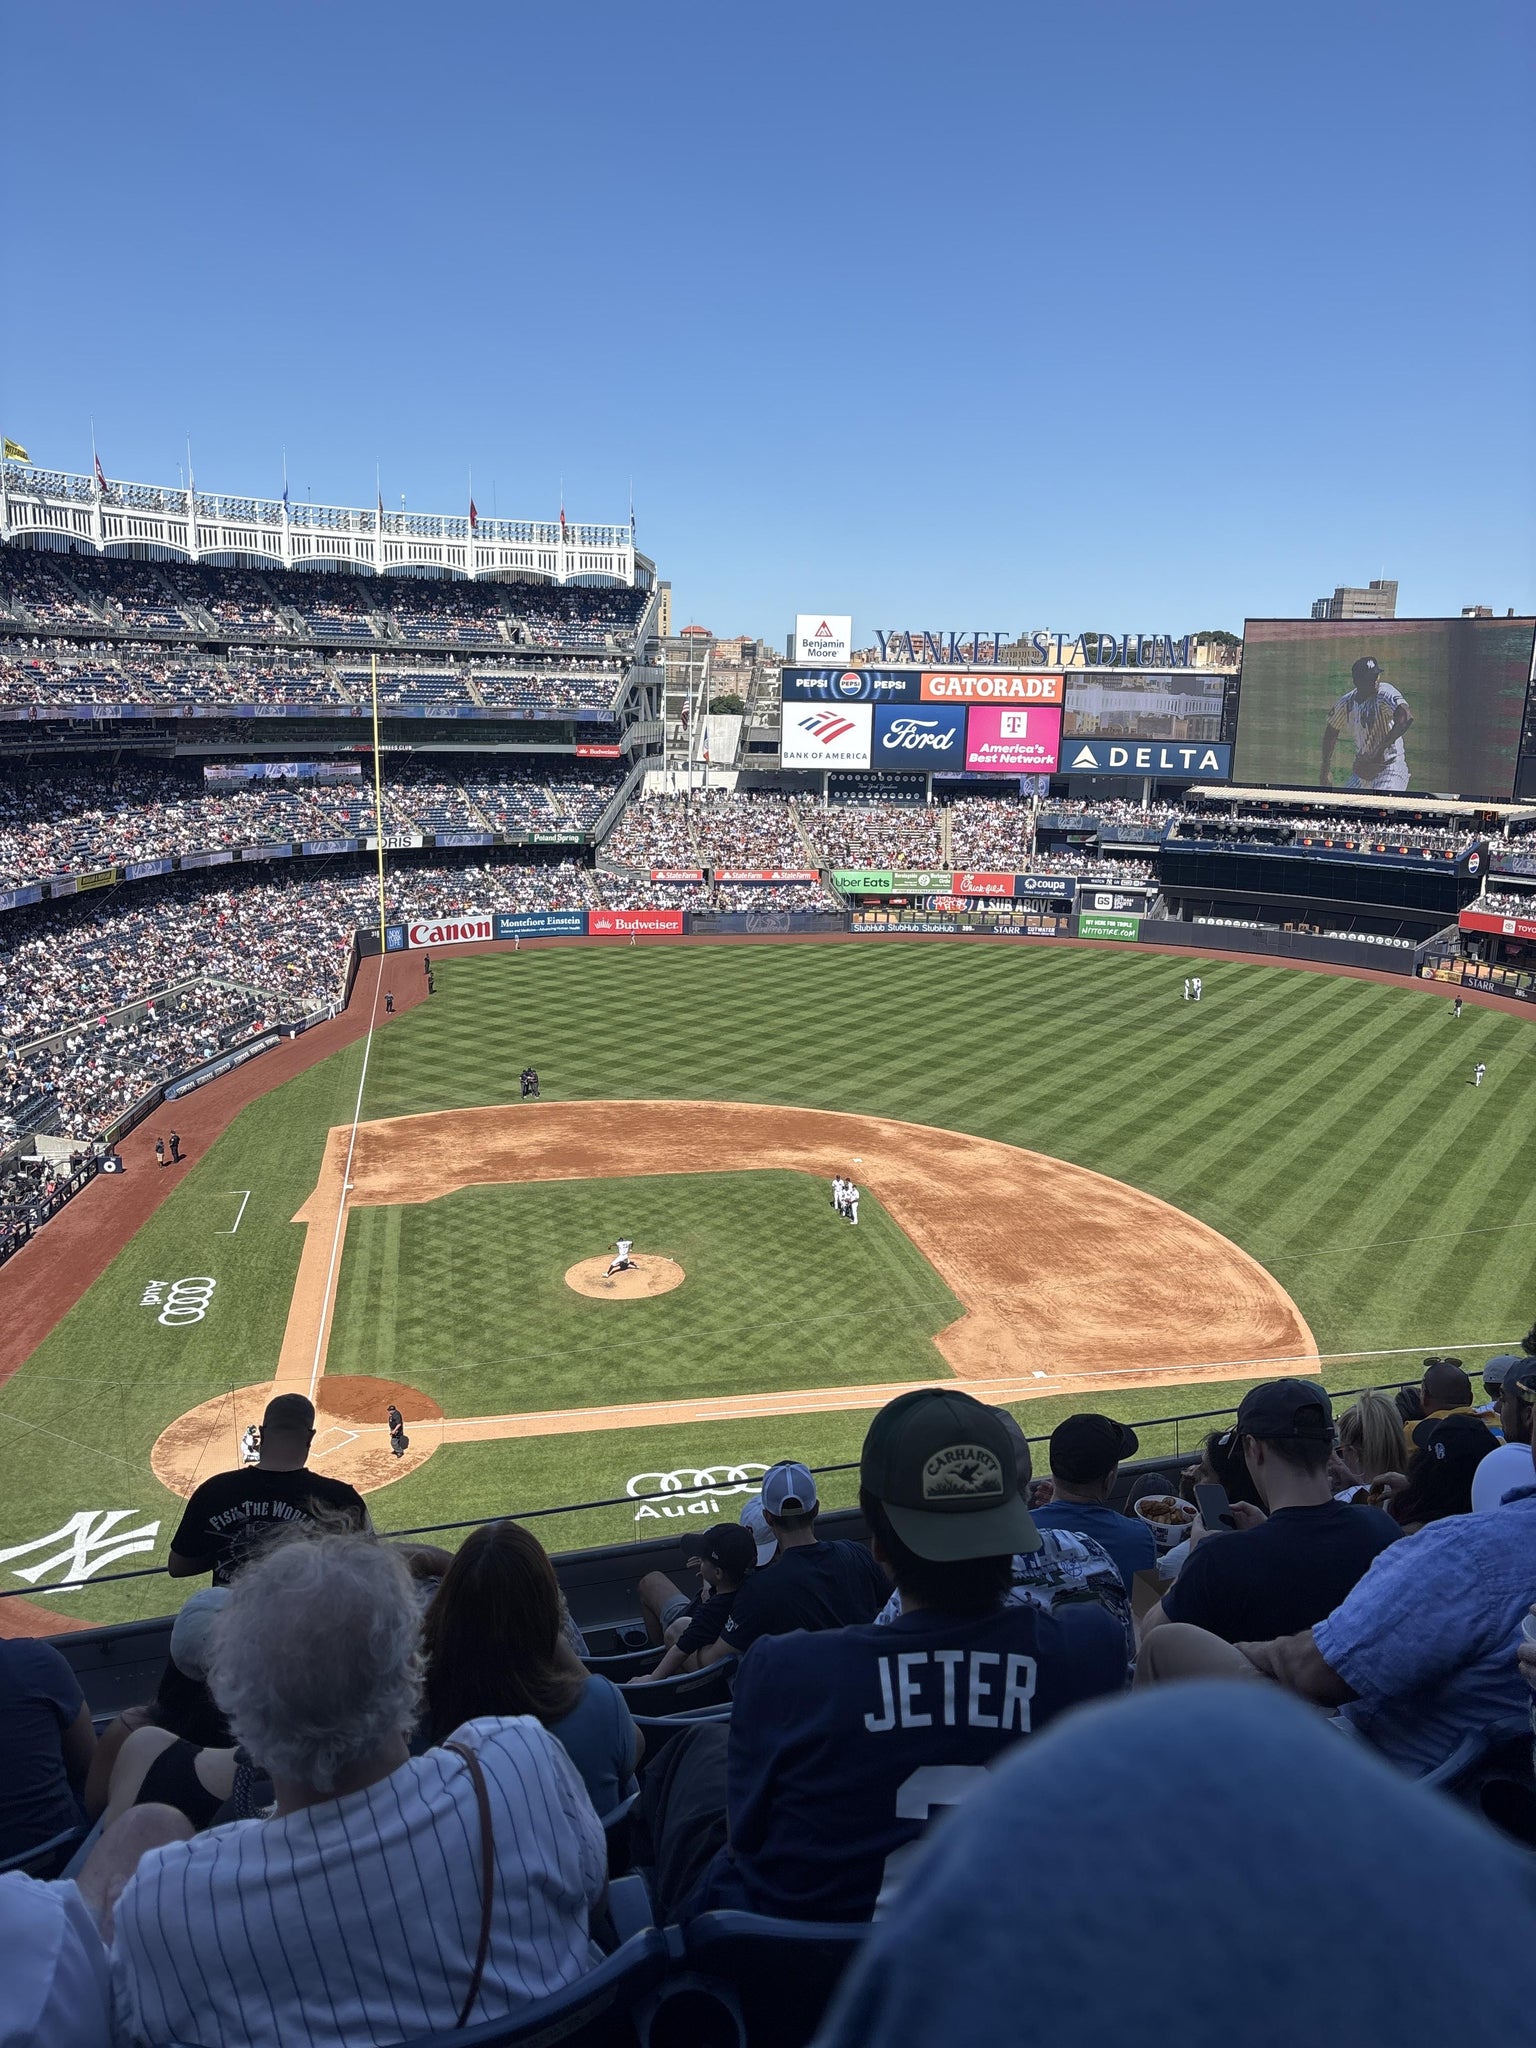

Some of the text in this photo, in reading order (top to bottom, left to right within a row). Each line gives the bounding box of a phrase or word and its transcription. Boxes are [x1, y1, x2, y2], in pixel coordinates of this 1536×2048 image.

[802, 639, 845, 651] Benjamin
[872, 630, 1194, 667] YANKEE STADIUM
[807, 648, 838, 658] Moore
[796, 678, 828, 688] PEPSI
[873, 680, 906, 690] PEPSI
[929, 677, 1056, 698] GATORADE
[882, 718, 957, 751] Ford
[783, 751, 868, 760] BANK OF AMERICA
[968, 752, 1055, 764] Best Network
[1108, 747, 1220, 771] DELTA
[534, 834, 579, 844] Poland Spring
[835, 878, 861, 887] Uber
[863, 877, 890, 888] Eats
[1037, 880, 1065, 890] coupa
[977, 898, 1054, 913] A SUB ABOVE
[1097, 897, 1110, 905] GS
[500, 916, 580, 927] Montefiore Einstein
[615, 919, 678, 929] Budweiser
[410, 921, 490, 945] Canon
[854, 924, 954, 932] StubHub StubHub StubHub
[994, 926, 1020, 934] STARR
[1081, 927, 1136, 937] NITTOTIRE.COM
[1468, 978, 1495, 992] STARR
[139, 1280, 169, 1306] Audi
[241, 1500, 269, 1517] THE
[634, 1499, 720, 1521] Audi
[864, 1650, 1037, 1733] JETER
